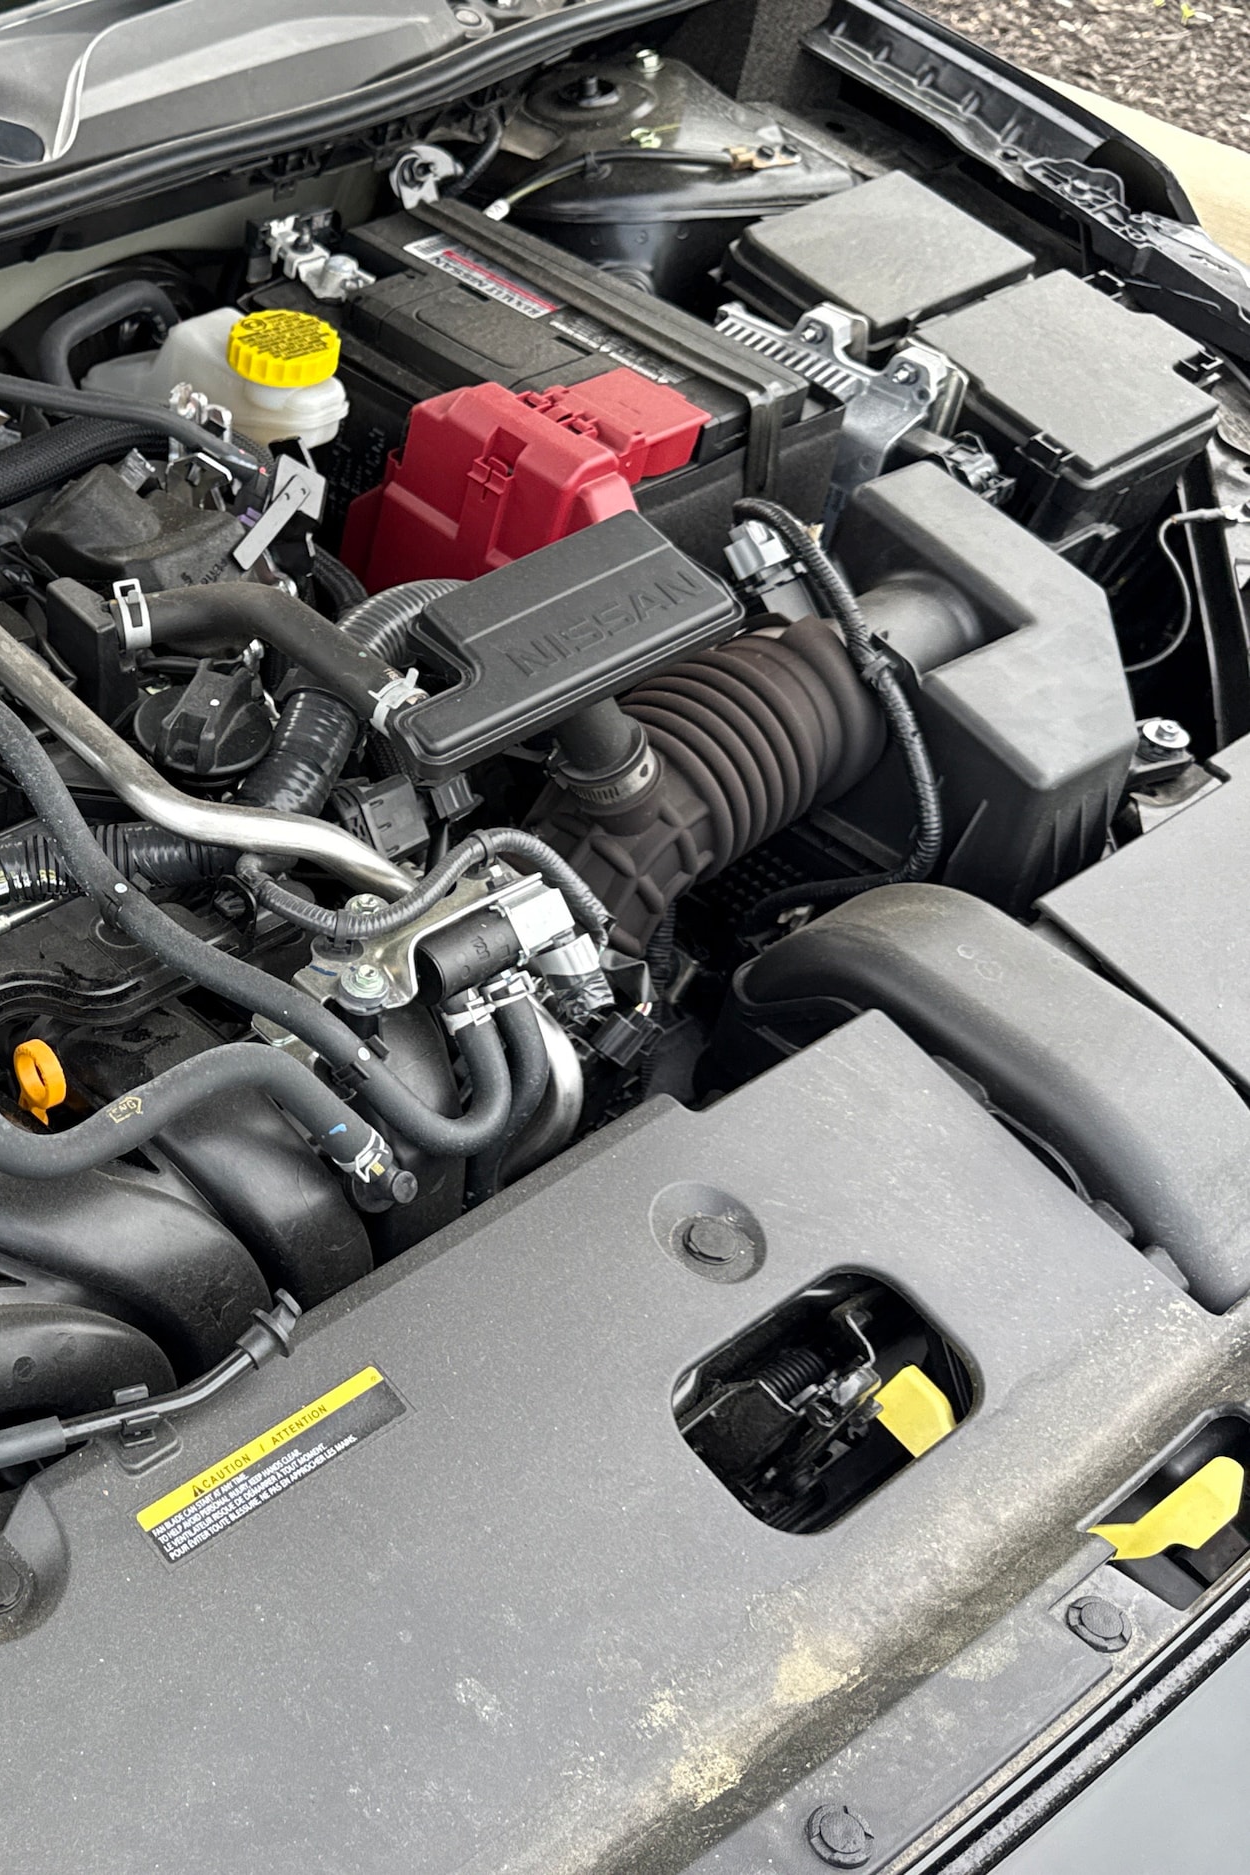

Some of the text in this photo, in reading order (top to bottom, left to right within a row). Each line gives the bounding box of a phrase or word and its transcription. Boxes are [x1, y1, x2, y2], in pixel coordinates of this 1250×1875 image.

[500, 570, 703, 677] NISSAN
[201, 1453, 251, 1489] CAUTION
[269, 1403, 327, 1445] ATTENTION
[151, 1523, 166, 1537] FAN
[163, 1511, 185, 1529] BLADE
[181, 1503, 197, 1518] CAN
[194, 1493, 214, 1509] START
[211, 1488, 222, 1498] AT
[219, 1480, 234, 1493] ANY
[157, 1533, 169, 1544] TO
[166, 1523, 184, 1538] HELP
[260, 1459, 283, 1477] HANDS
[162, 1541, 174, 1552] LE
[170, 1515, 213, 1547] VENTILATEUR
[210, 1500, 236, 1521] RISQUE
[233, 1495, 245, 1506] DE
[279, 1459, 299, 1476] TOUT
[168, 1542, 190, 1560] POUR
[207, 1515, 231, 1534] TOUTE
[258, 1489, 270, 1502] NE
[267, 1482, 282, 1496] PAS
[278, 1476, 291, 1488] EN
[288, 1453, 326, 1482] APPROCHER
[323, 1446, 337, 1459] LES
